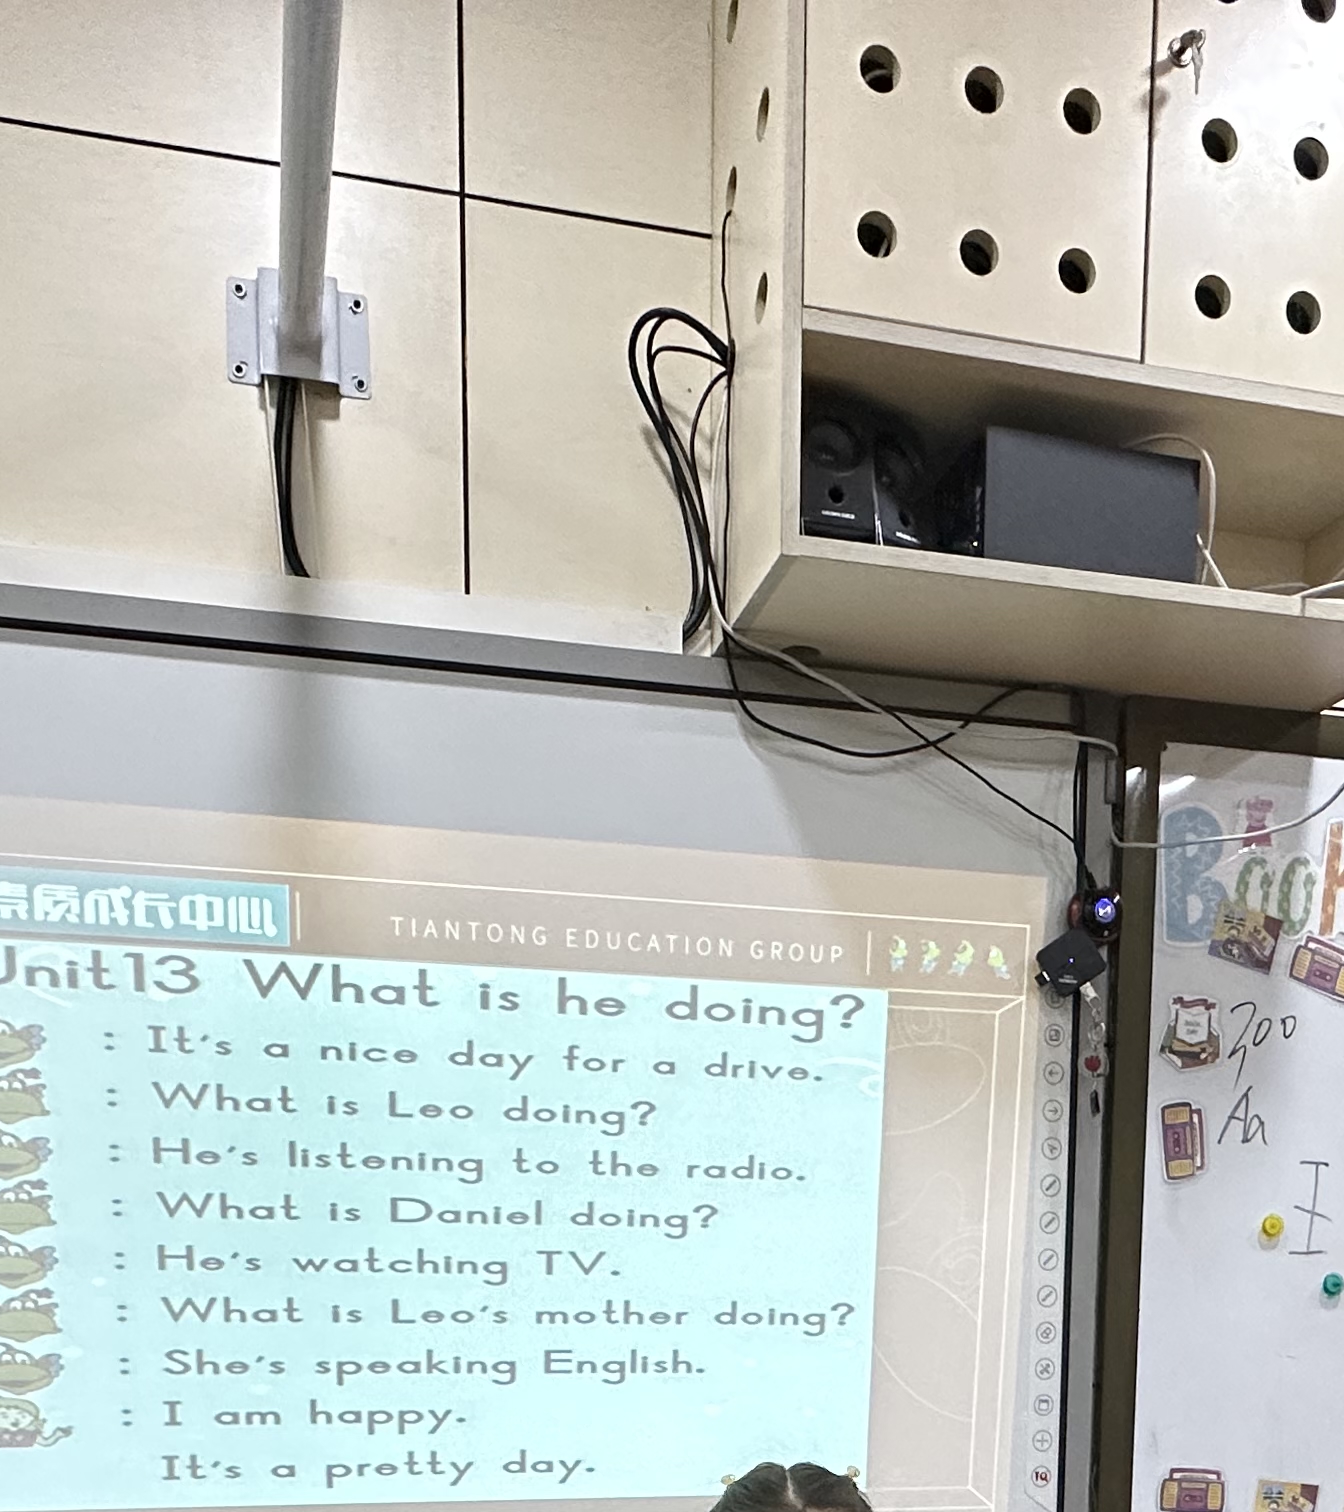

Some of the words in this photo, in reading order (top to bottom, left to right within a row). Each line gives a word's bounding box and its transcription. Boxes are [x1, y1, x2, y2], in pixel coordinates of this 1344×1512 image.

[390, 915, 549, 948] TIANTONG
[565, 927, 735, 958] EDUCATION
[749, 939, 845, 964] GROUP
[244, 958, 440, 1007] What
[479, 980, 520, 1012] is
[557, 977, 626, 1018] he
[665, 985, 866, 1043] doing?
[148, 1025, 232, 1057] It's
[263, 1040, 290, 1058] a
[320, 1041, 418, 1066] nice
[448, 1039, 534, 1080] day
[562, 1045, 626, 1073] for
[653, 1058, 675, 1076] a
[705, 1051, 824, 1083] drive.
[151, 1081, 298, 1113] What
[326, 1094, 359, 1116] is
[388, 1091, 474, 1121] Leo
[504, 1097, 656, 1136] doing?
[1217, 1085, 1268, 1145] Aa
[152, 1137, 258, 1166] He's
[287, 1142, 483, 1183] listening
[513, 1148, 559, 1175] to
[588, 1150, 659, 1178] the
[686, 1155, 806, 1183] radio.
[156, 1191, 300, 1221] What
[329, 1203, 360, 1223] is
[389, 1197, 543, 1226] Daniel
[570, 1202, 720, 1238] doing?
[156, 1244, 262, 1273] He's
[292, 1251, 508, 1286] watching
[536, 1250, 621, 1278] TV.
[160, 1296, 304, 1324] What
[331, 1305, 362, 1324] is
[392, 1300, 508, 1326] Leo's
[535, 1301, 689, 1327] mother
[714, 1302, 855, 1336] doing?
[163, 1350, 286, 1376] She's
[315, 1350, 517, 1385] speaking
[542, 1350, 706, 1385] English.
[163, 1400, 183, 1427] I
[213, 1407, 282, 1427] am
[309, 1400, 466, 1434] happy.
[161, 1455, 243, 1481] It's
[271, 1461, 297, 1480] a
[325, 1455, 473, 1488] pretty
[503, 1449, 595, 1483] day.
